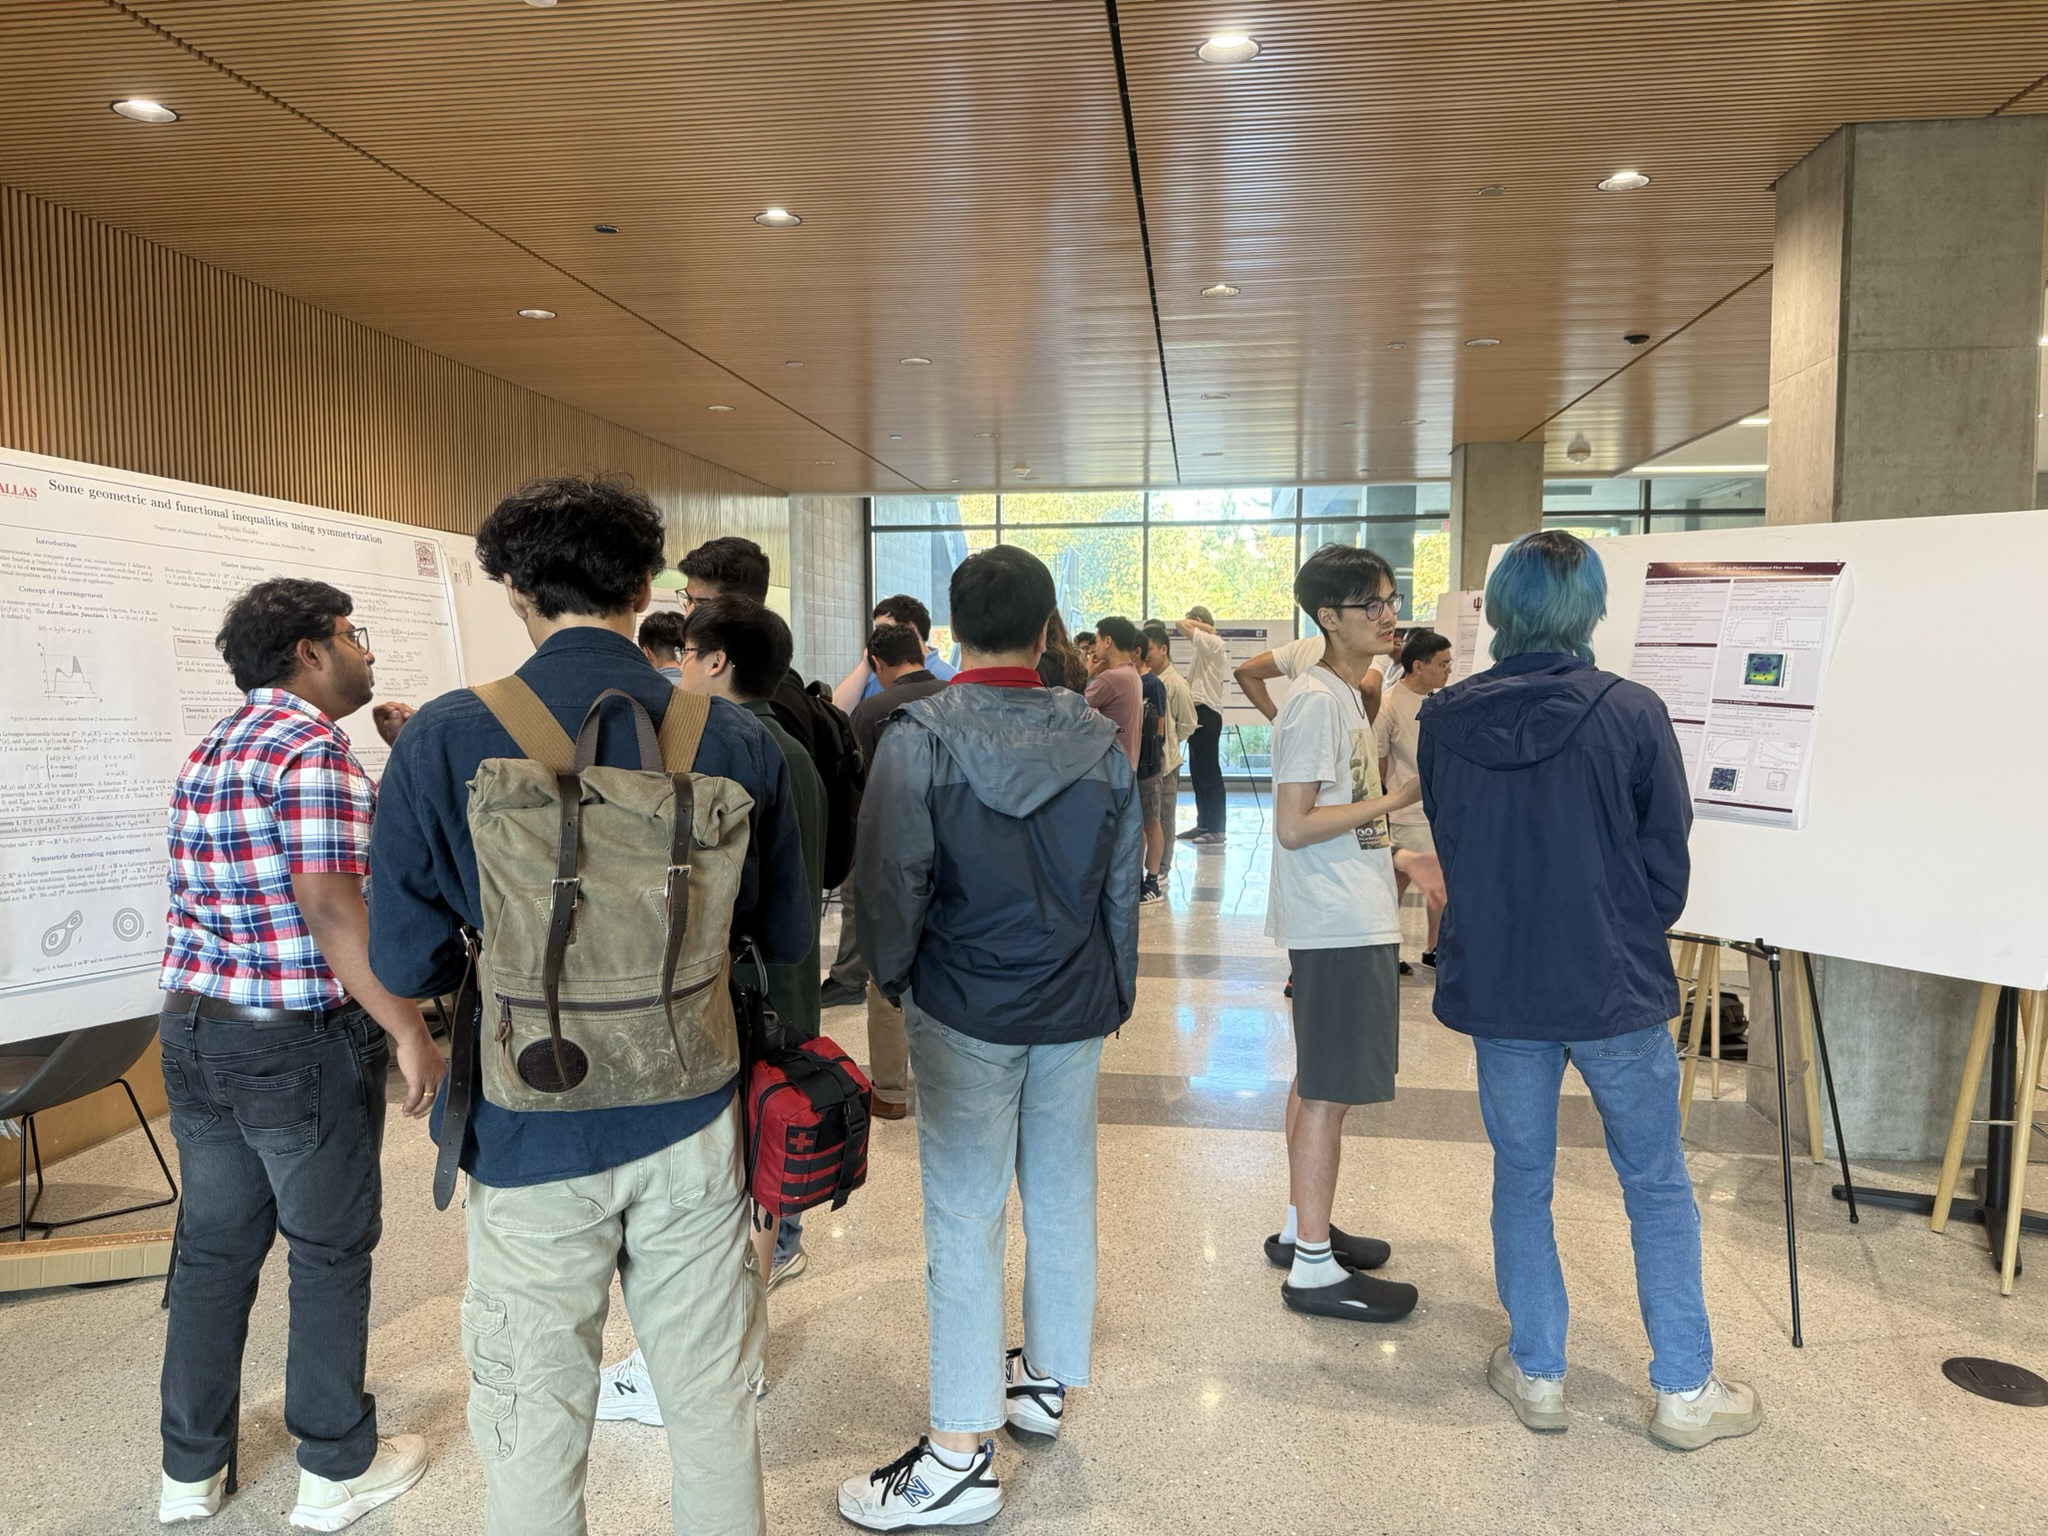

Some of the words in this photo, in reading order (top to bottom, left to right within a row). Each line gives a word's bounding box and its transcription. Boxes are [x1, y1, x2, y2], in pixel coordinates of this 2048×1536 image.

[48, 479, 84, 494] Some
[89, 488, 147, 505] geometric
[151, 499, 172, 510] and
[176, 500, 229, 519] functional
[232, 510, 288, 528] inequalities
[291, 522, 315, 535] using
[317, 526, 382, 544] symmetrization
[36, 538, 77, 548] Introduction
[18, 585, 47, 595] Concept
[56, 591, 103, 599] rearrangement
[32, 852, 68, 863] Symmetric
[70, 850, 104, 860] decreasing
[105, 847, 151, 857] rearrangement
[614, 1380, 637, 1395] N
[897, 1475, 935, 1507] N
